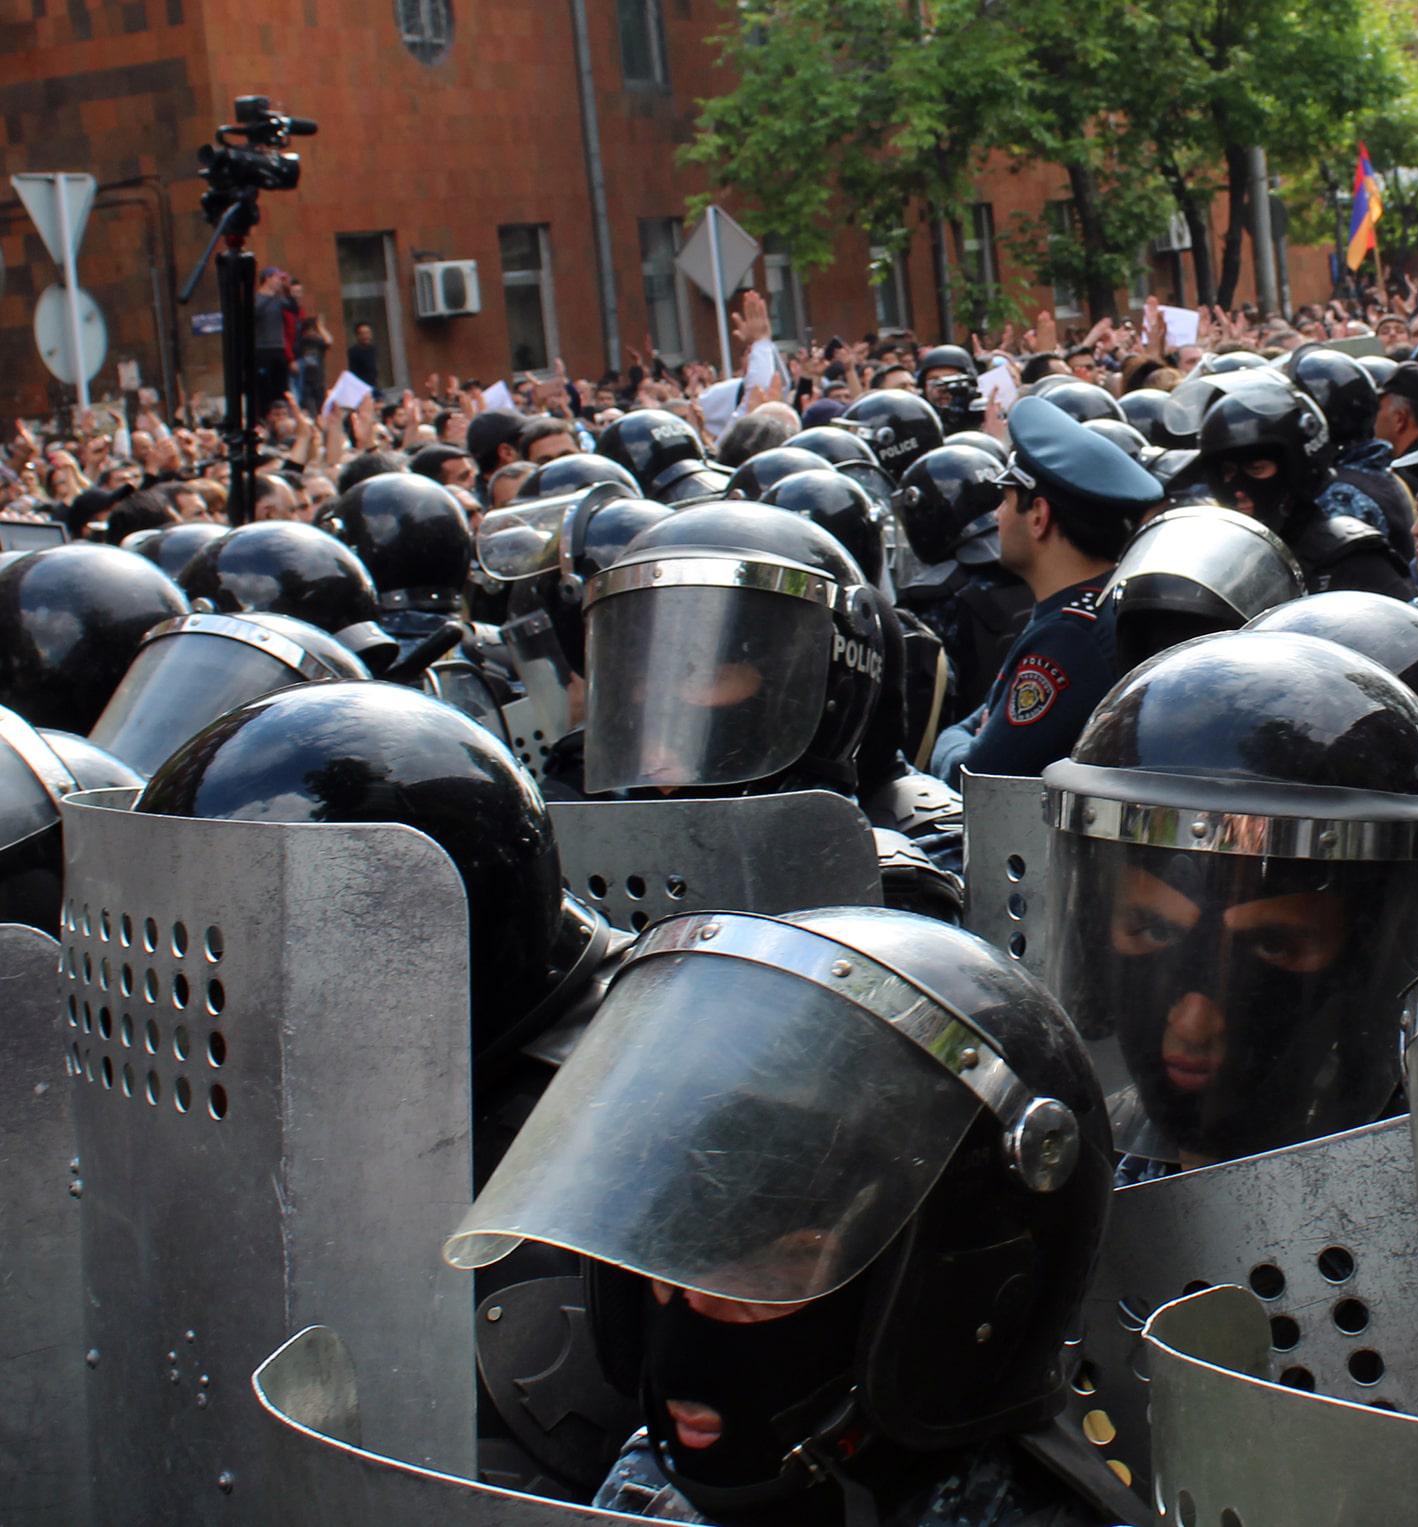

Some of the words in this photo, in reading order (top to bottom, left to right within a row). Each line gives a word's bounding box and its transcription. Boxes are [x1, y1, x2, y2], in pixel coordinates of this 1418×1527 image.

[879, 437, 919, 460] POLICE
[832, 634, 884, 684] POLICE
[1022, 657, 1067, 685] POLICE
